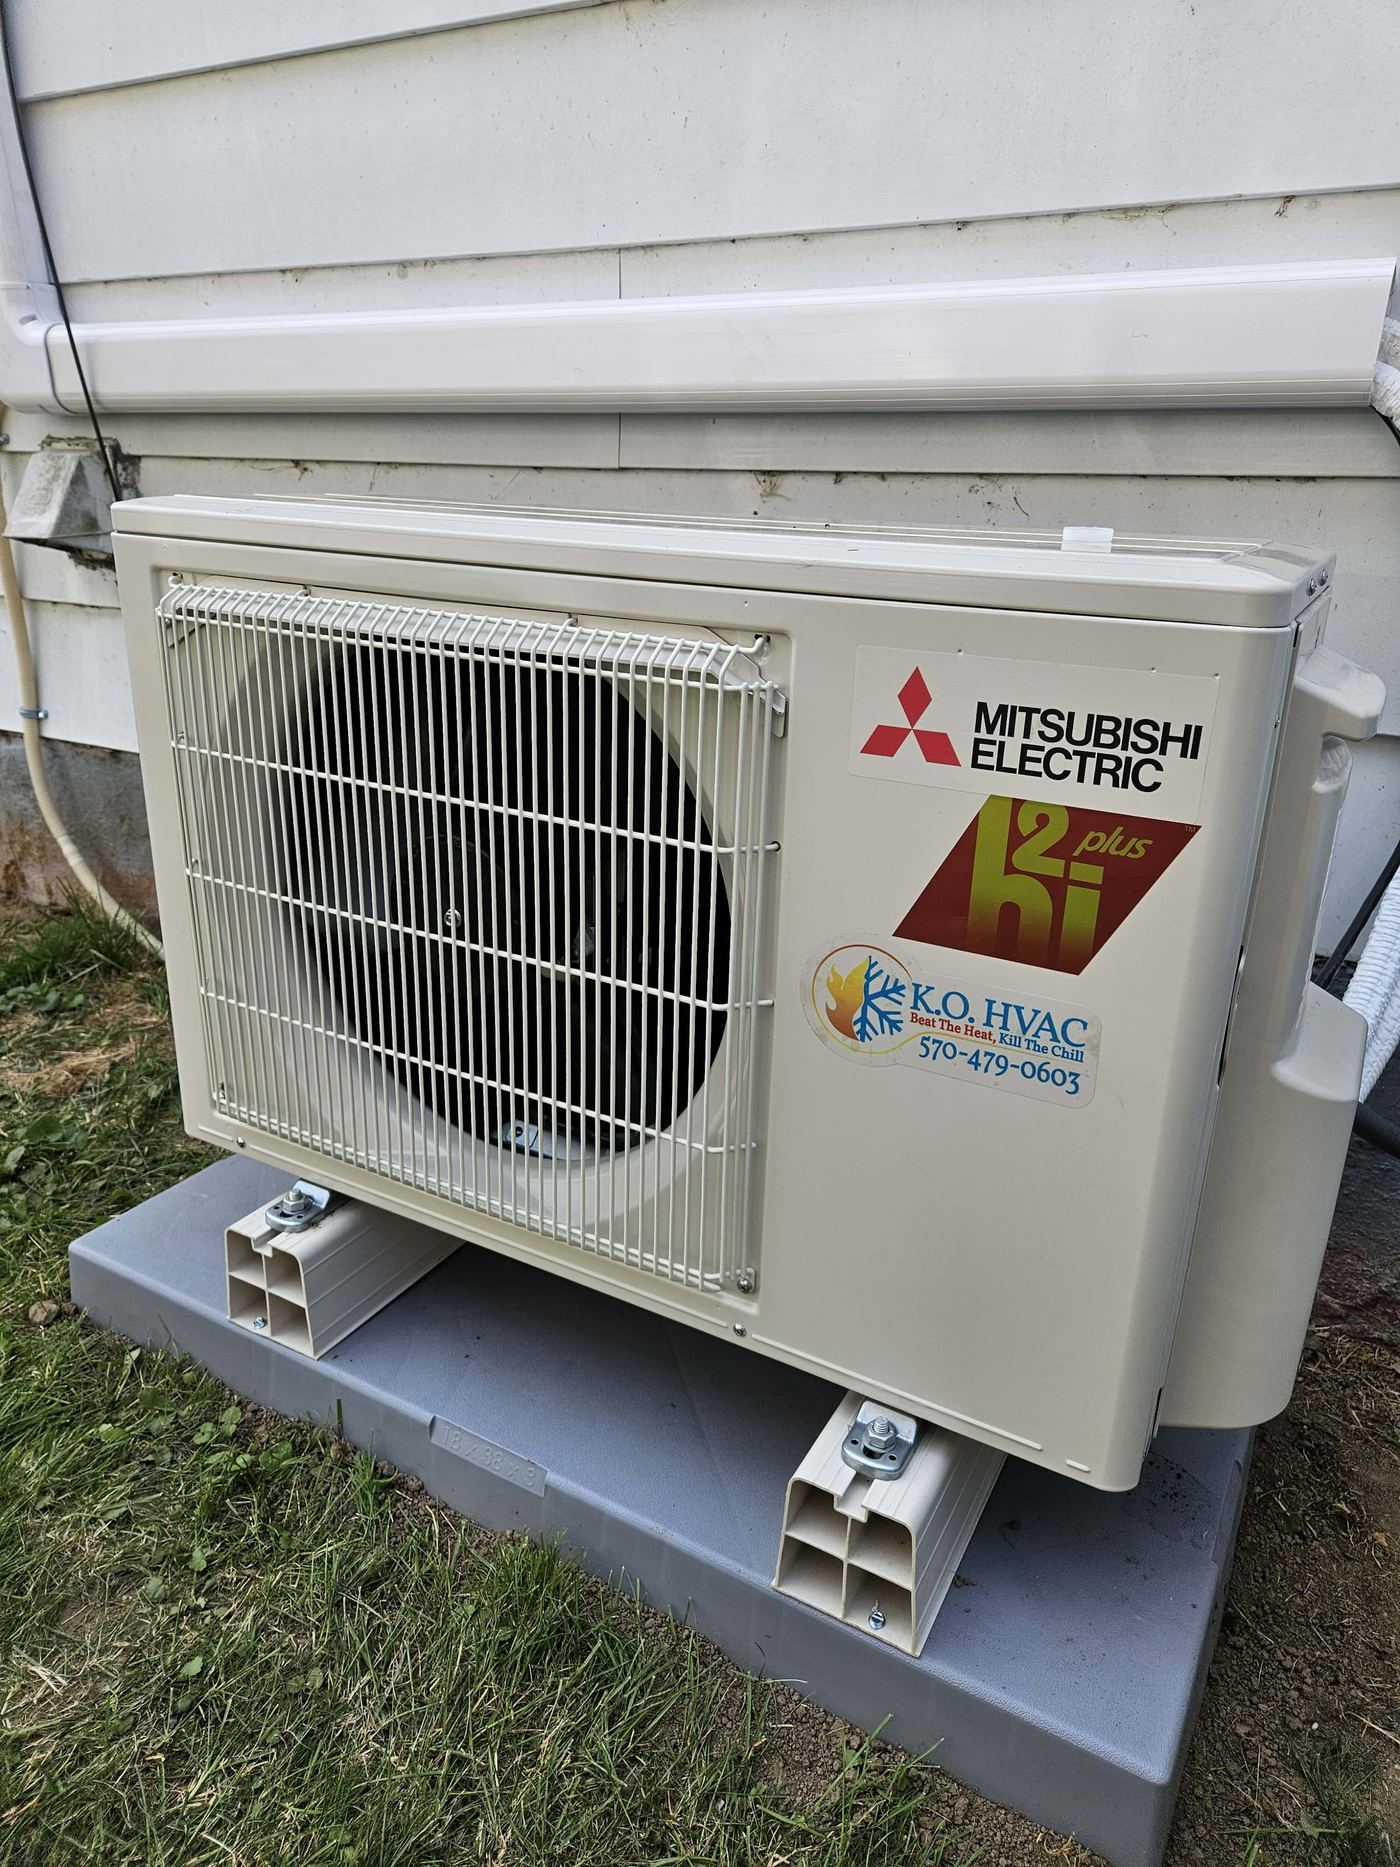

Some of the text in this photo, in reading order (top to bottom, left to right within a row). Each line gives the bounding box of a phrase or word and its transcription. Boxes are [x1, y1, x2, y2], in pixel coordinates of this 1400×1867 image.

[974, 701, 1203, 760] MITSUBISHI
[970, 737, 1164, 793] ELECTRIC
[1072, 826, 1153, 860] plus
[910, 982, 1088, 1047] K.O. HVAC
[910, 1011, 1084, 1063] Beat The Heat, Kill The Chill
[918, 1035, 1081, 1096] 570-479-0603
